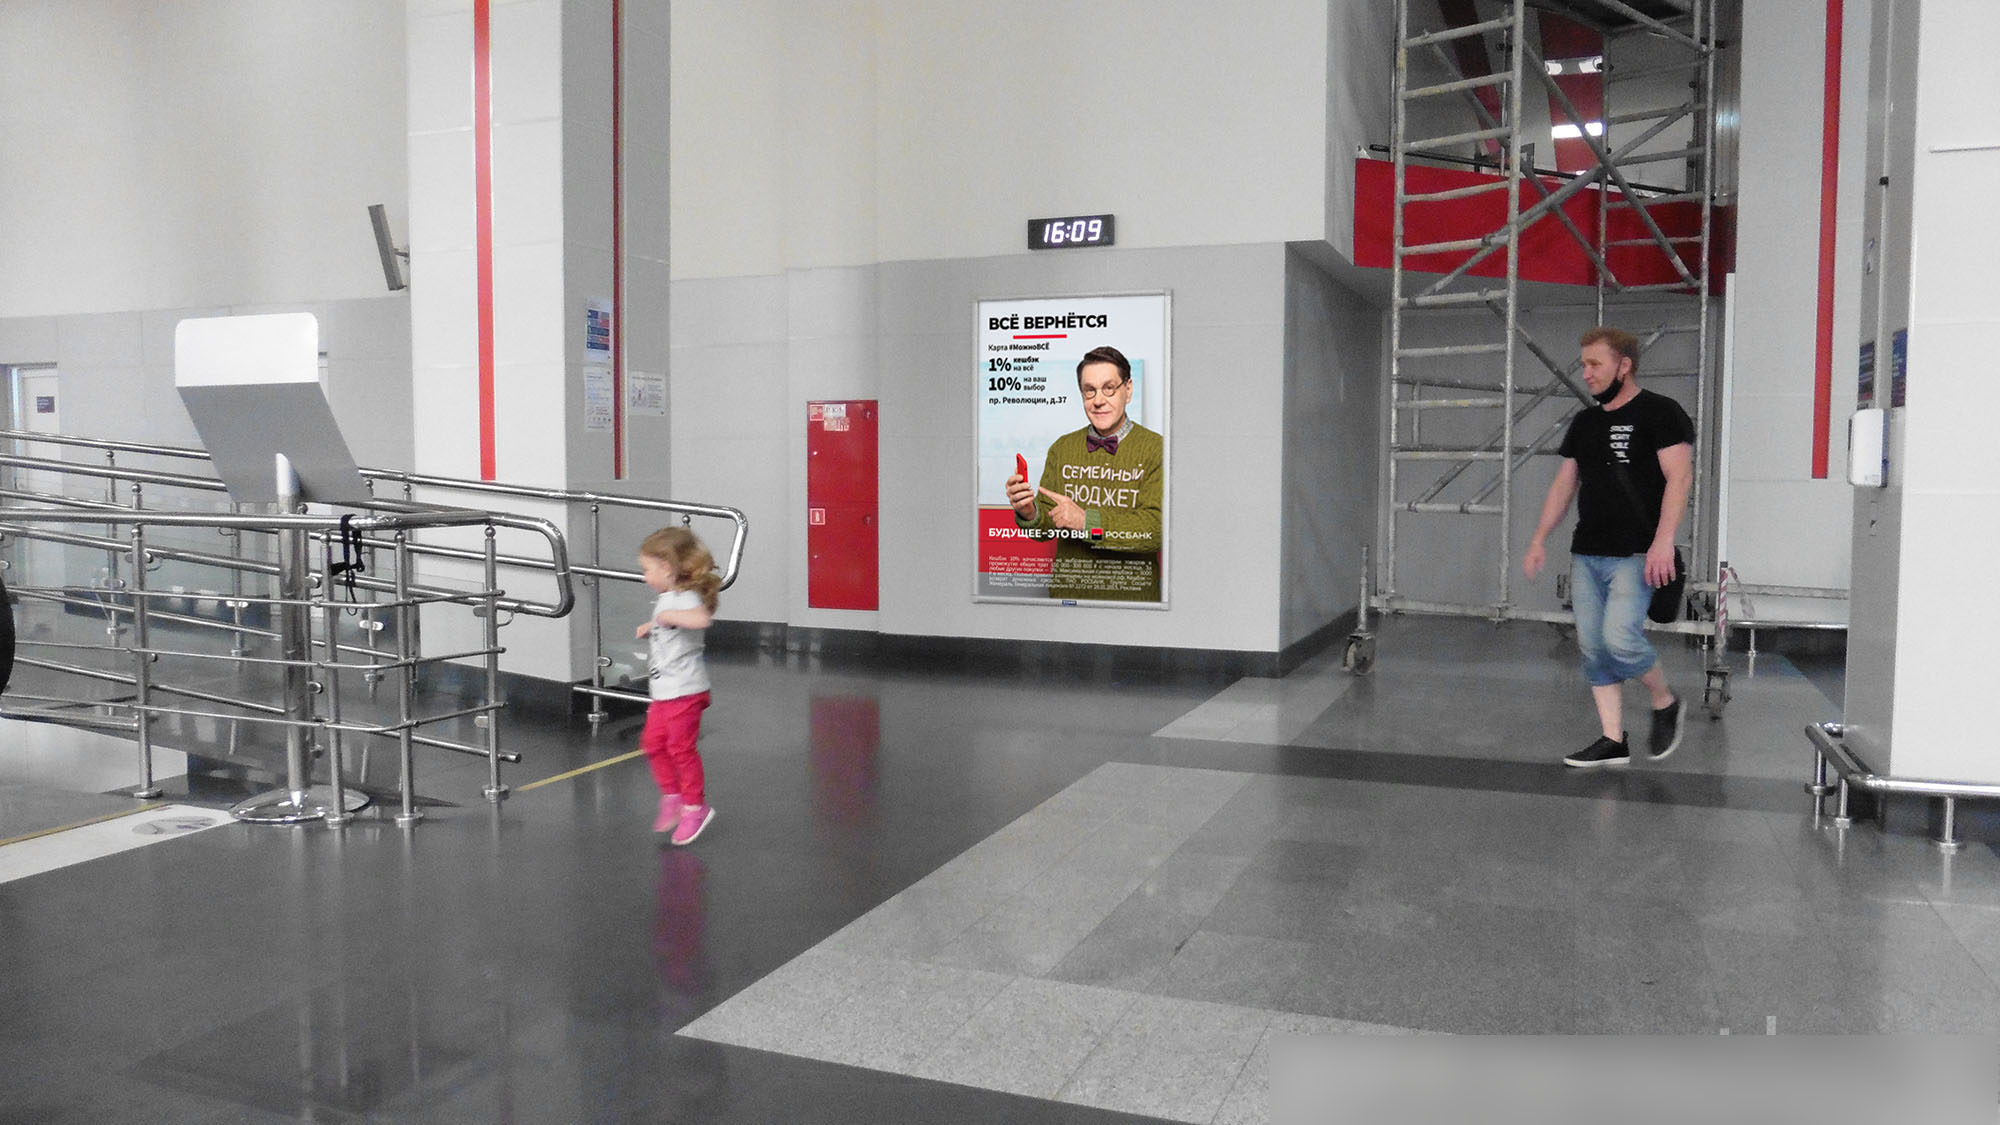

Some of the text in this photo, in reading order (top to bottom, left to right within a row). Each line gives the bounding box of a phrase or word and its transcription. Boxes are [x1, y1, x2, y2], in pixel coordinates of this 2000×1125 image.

[1044, 219, 1102, 243] 16:09
[989, 312, 1107, 330] ВСЁ ВЕРНЁТСЯ
[1009, 342, 1050, 351] #МожноВСЁ
[988, 358, 1012, 372] 1%
[1013, 356, 1040, 364] кешбэк
[988, 377, 1021, 391] 10%
[1002, 396, 1049, 404] Революции,
[1062, 463, 1144, 482] СЕМЕЙНЫЙ
[1064, 484, 1139, 508] БЮДЖЕТ
[1071, 529, 1089, 539] ВЫ
[1105, 531, 1153, 540] РОСБАНК
